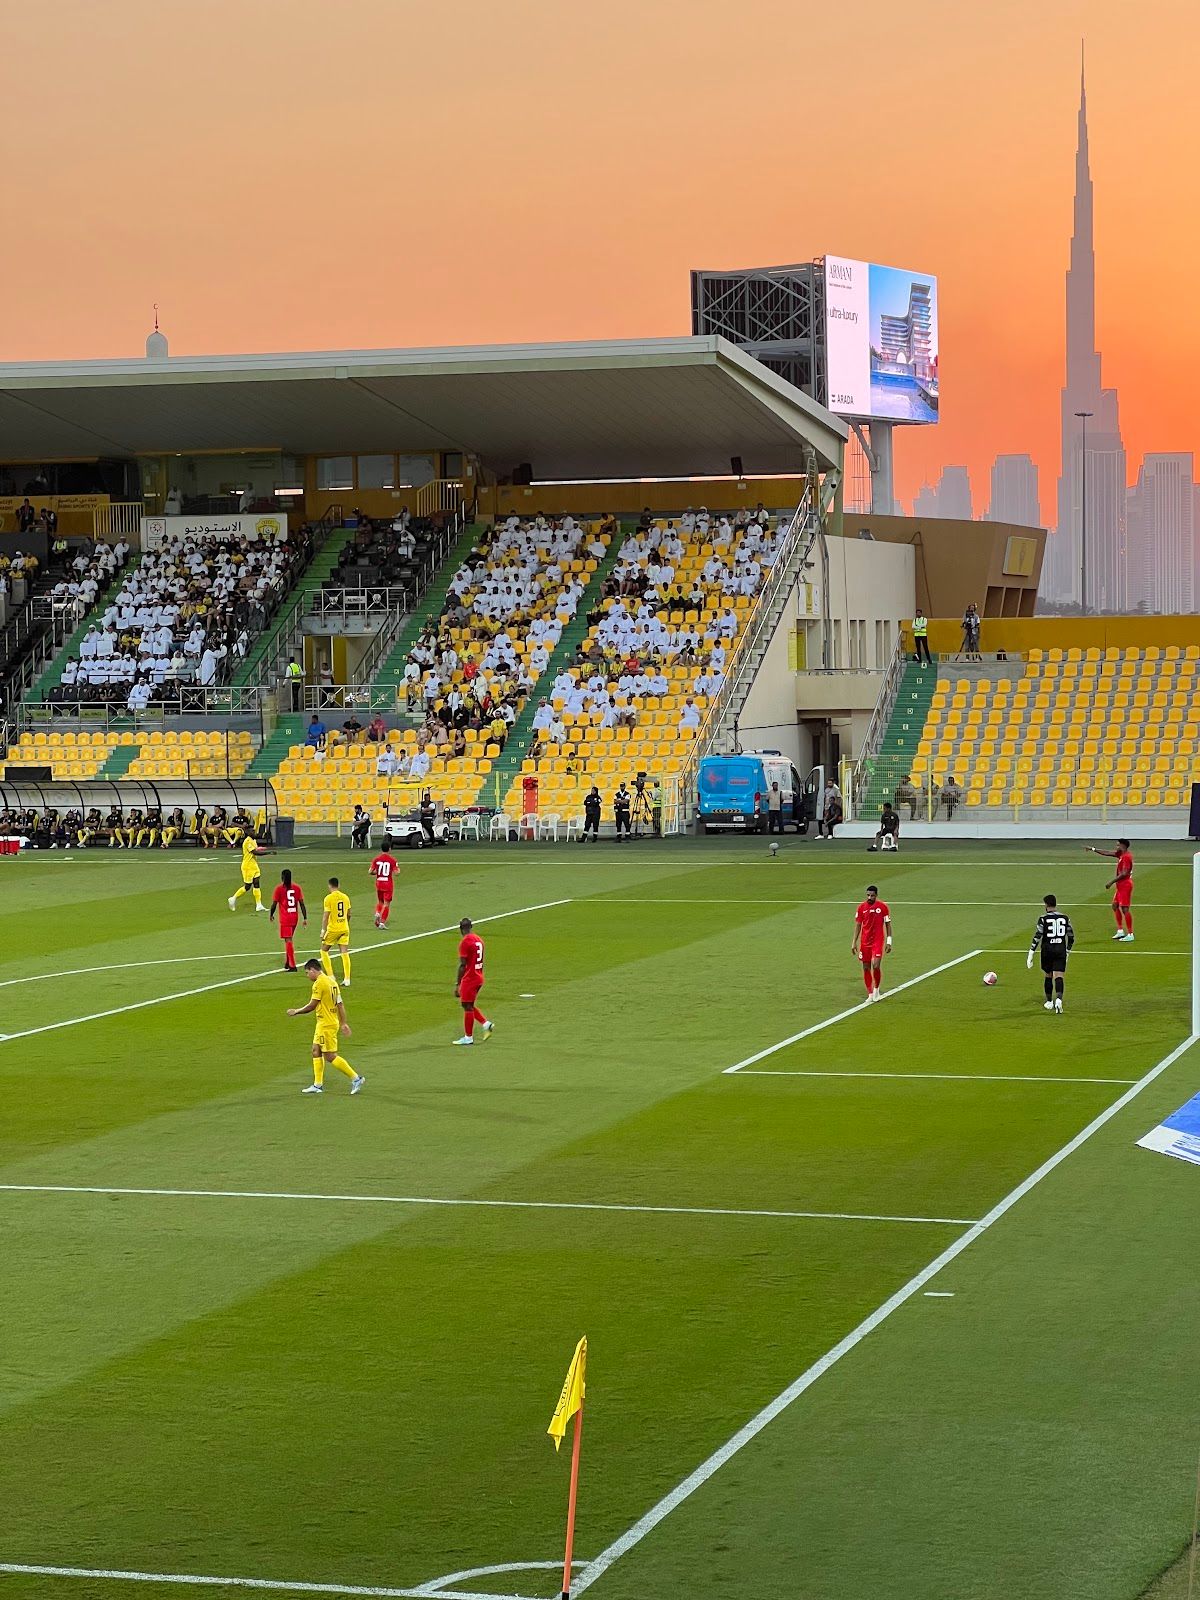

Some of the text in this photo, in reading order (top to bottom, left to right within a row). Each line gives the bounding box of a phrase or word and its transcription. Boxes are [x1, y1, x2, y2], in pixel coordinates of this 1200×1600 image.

[829, 264, 852, 282] ARMANI
[830, 306, 858, 324] ultra-luxury
[837, 394, 854, 404] ARADA
[184, 522, 241, 535] الاستوديو
[376, 862, 390, 876] 70
[287, 890, 295, 906] 5
[338, 902, 344, 917] 9
[1046, 918, 1066, 937] 36
[475, 942, 483, 961] 3
